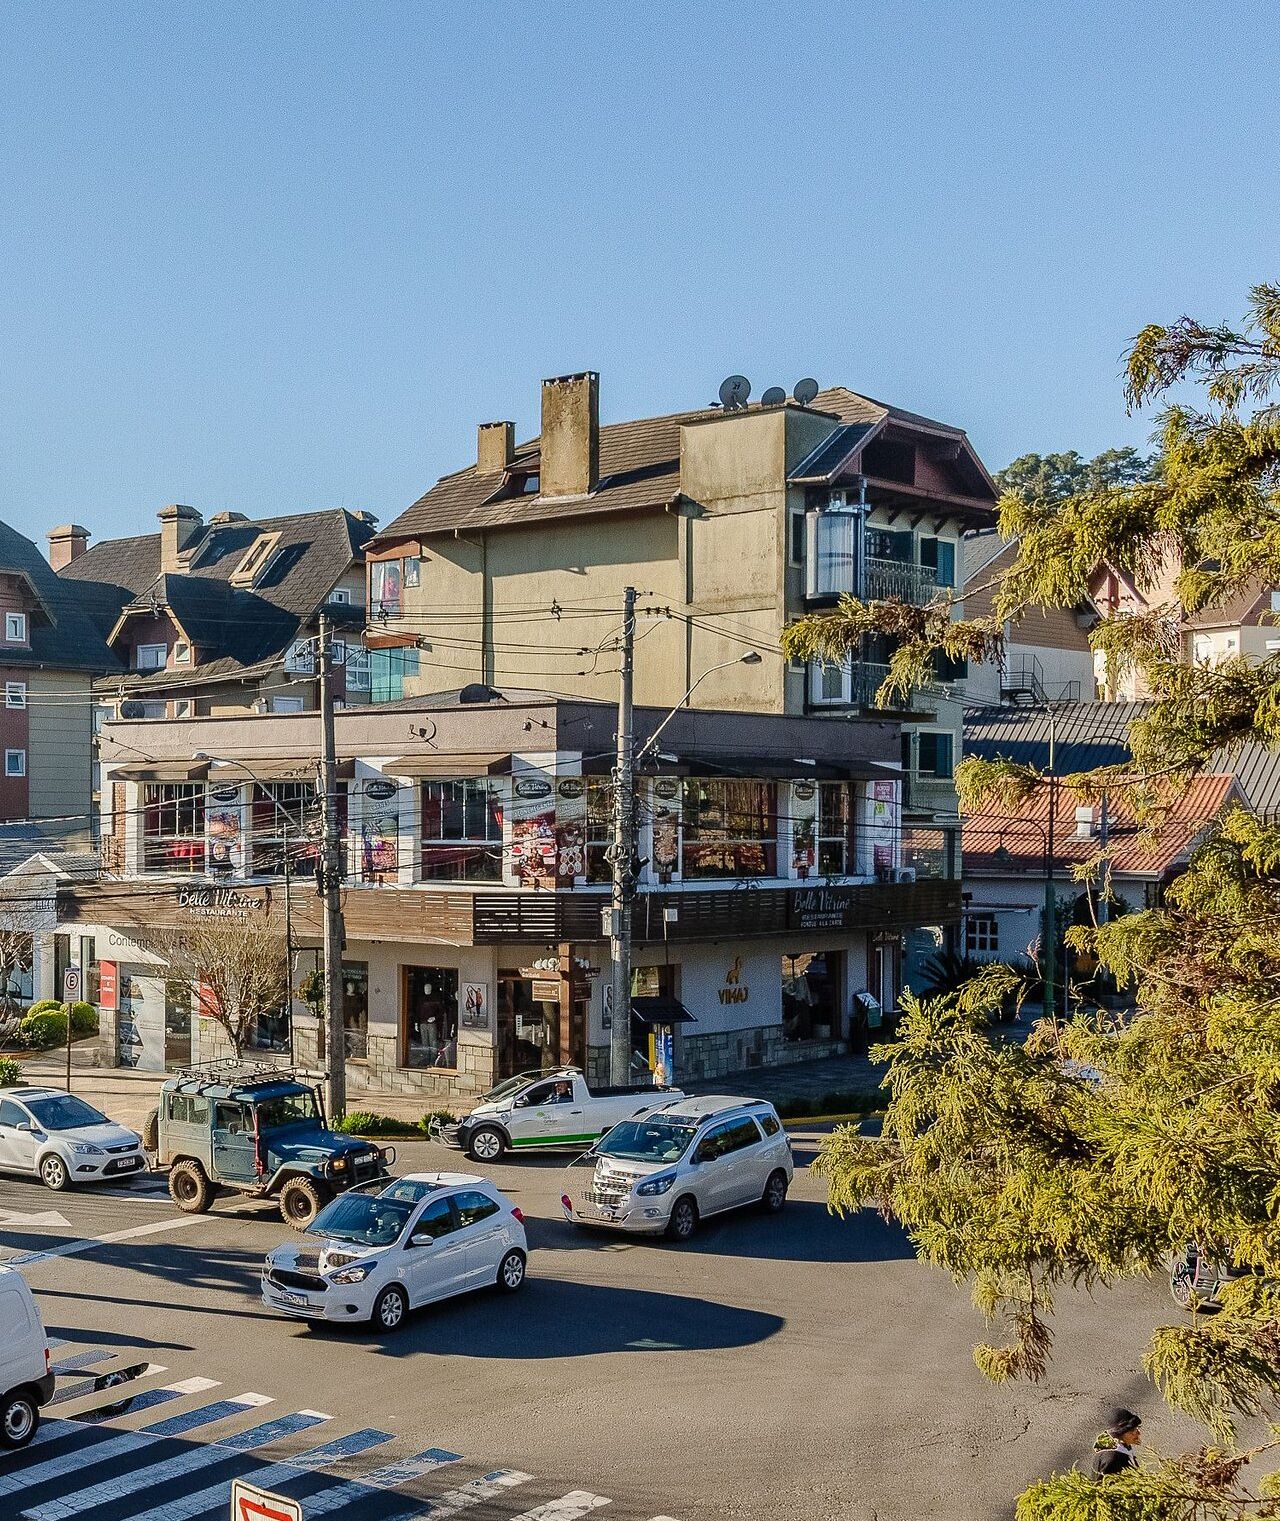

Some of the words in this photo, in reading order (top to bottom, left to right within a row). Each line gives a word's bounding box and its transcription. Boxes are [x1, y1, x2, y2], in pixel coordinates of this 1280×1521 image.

[179, 886, 210, 907] Belle
[794, 890, 817, 913] Belle
[818, 890, 850, 911] Vitrine
